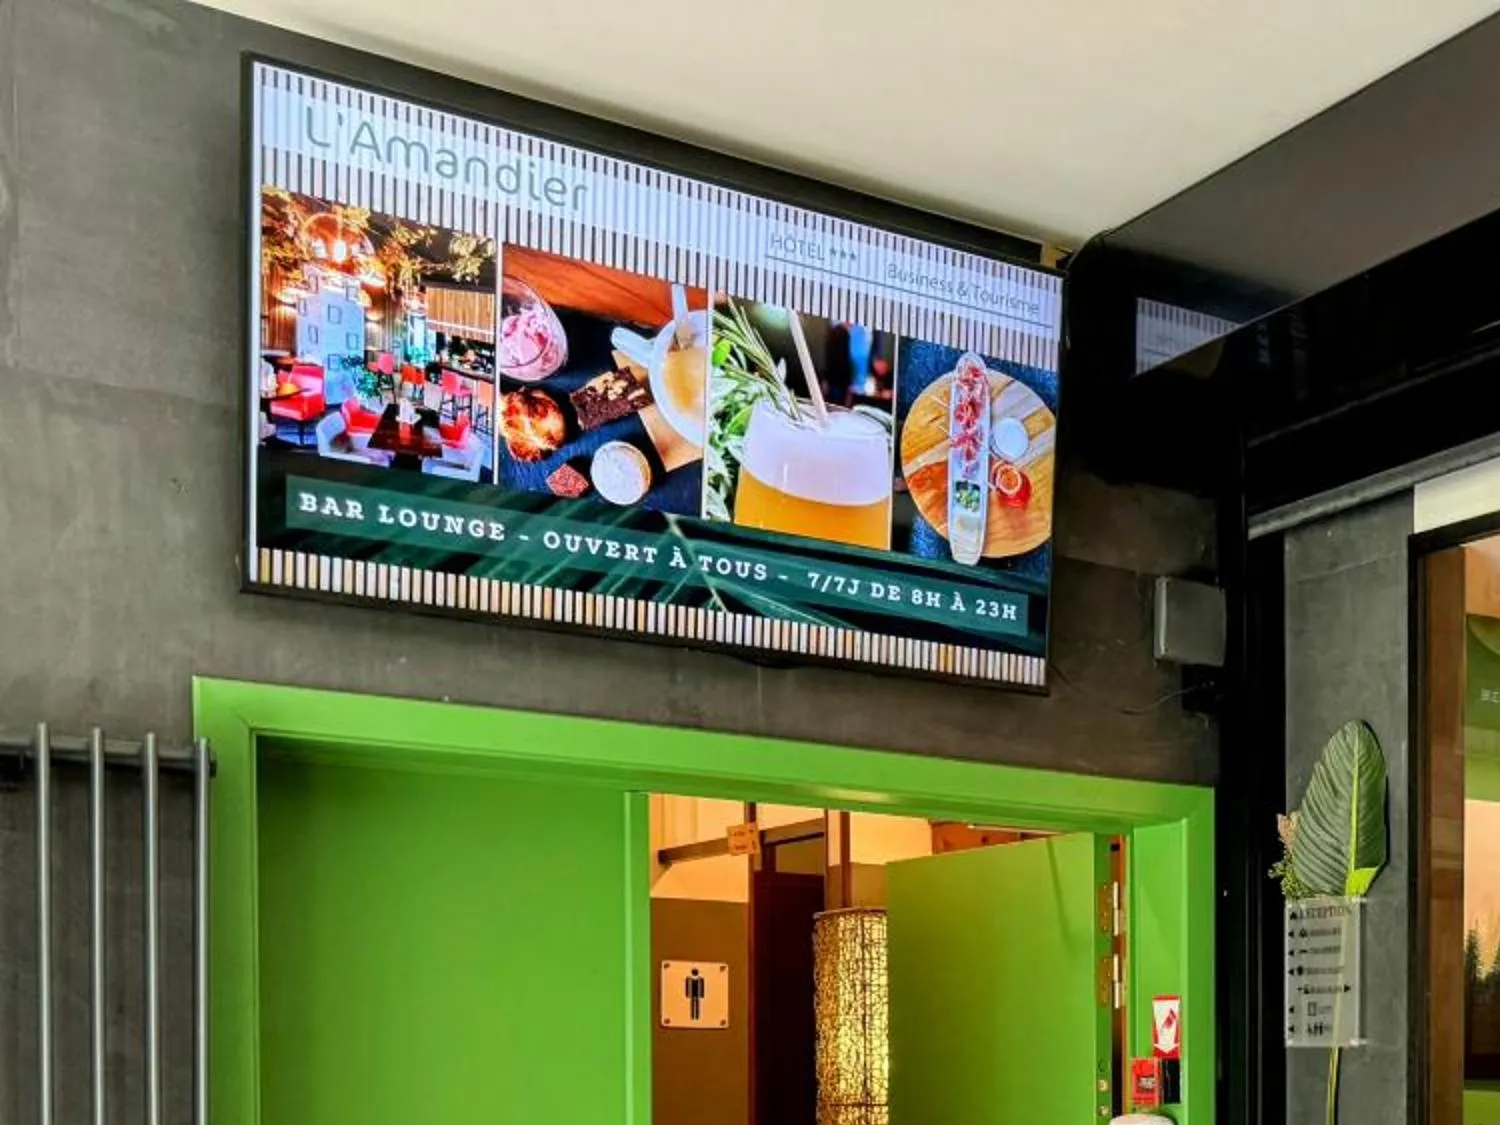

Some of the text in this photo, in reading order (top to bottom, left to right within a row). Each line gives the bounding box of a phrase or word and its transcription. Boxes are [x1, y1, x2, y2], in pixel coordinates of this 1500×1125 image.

[306, 105, 589, 211] L'Amandier
[887, 263, 1041, 315] Business & Tourisme
[299, 492, 364, 520] BAR
[377, 505, 505, 541] LOUNGE
[543, 531, 658, 564] OUVERT
[668, 546, 687, 570] À
[699, 554, 767, 581] TOUS
[807, 571, 860, 596] 7/7J
[870, 583, 901, 602] DE
[911, 590, 941, 608] 8H
[951, 591, 966, 612] À
[975, 598, 1018, 621] 23H
